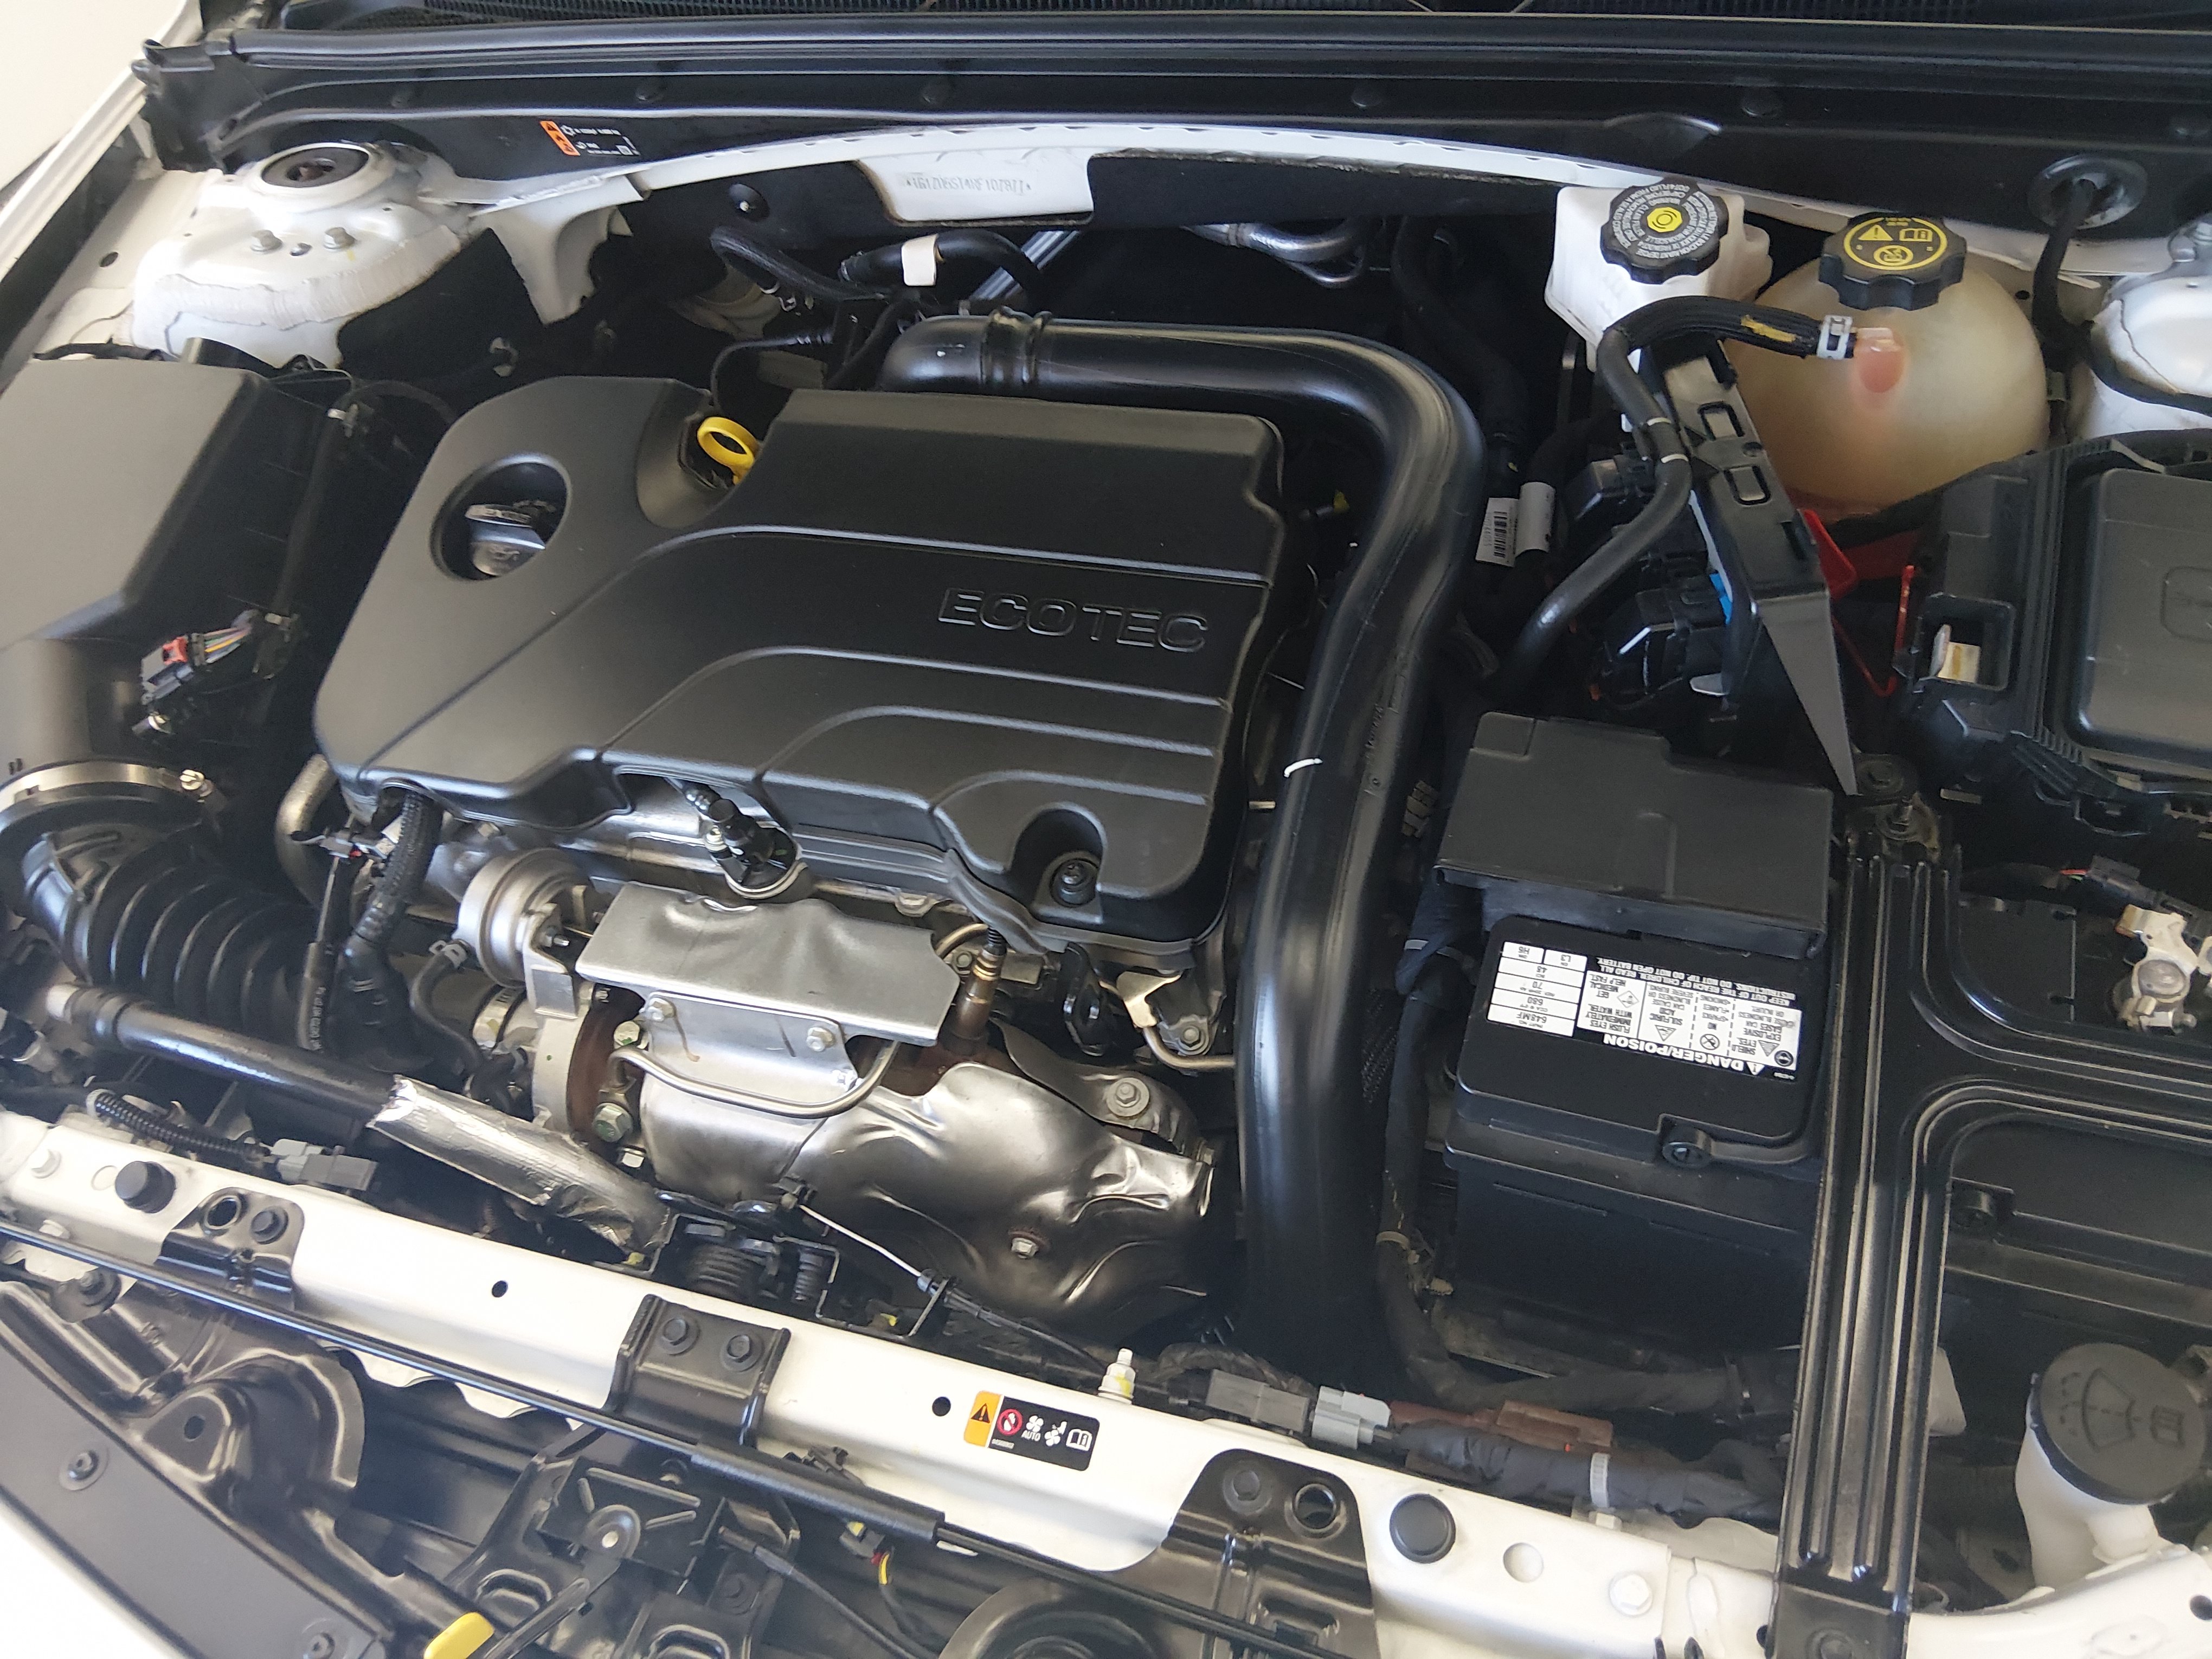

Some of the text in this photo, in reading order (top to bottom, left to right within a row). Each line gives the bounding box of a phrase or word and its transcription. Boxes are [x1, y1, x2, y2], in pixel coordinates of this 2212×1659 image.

[938, 588, 1208, 652] ECOTEC
[1532, 981, 1543, 989] 70
[1602, 1033, 1745, 1071] DANGER/POISON
[1021, 1430, 1041, 1442] AUTO
